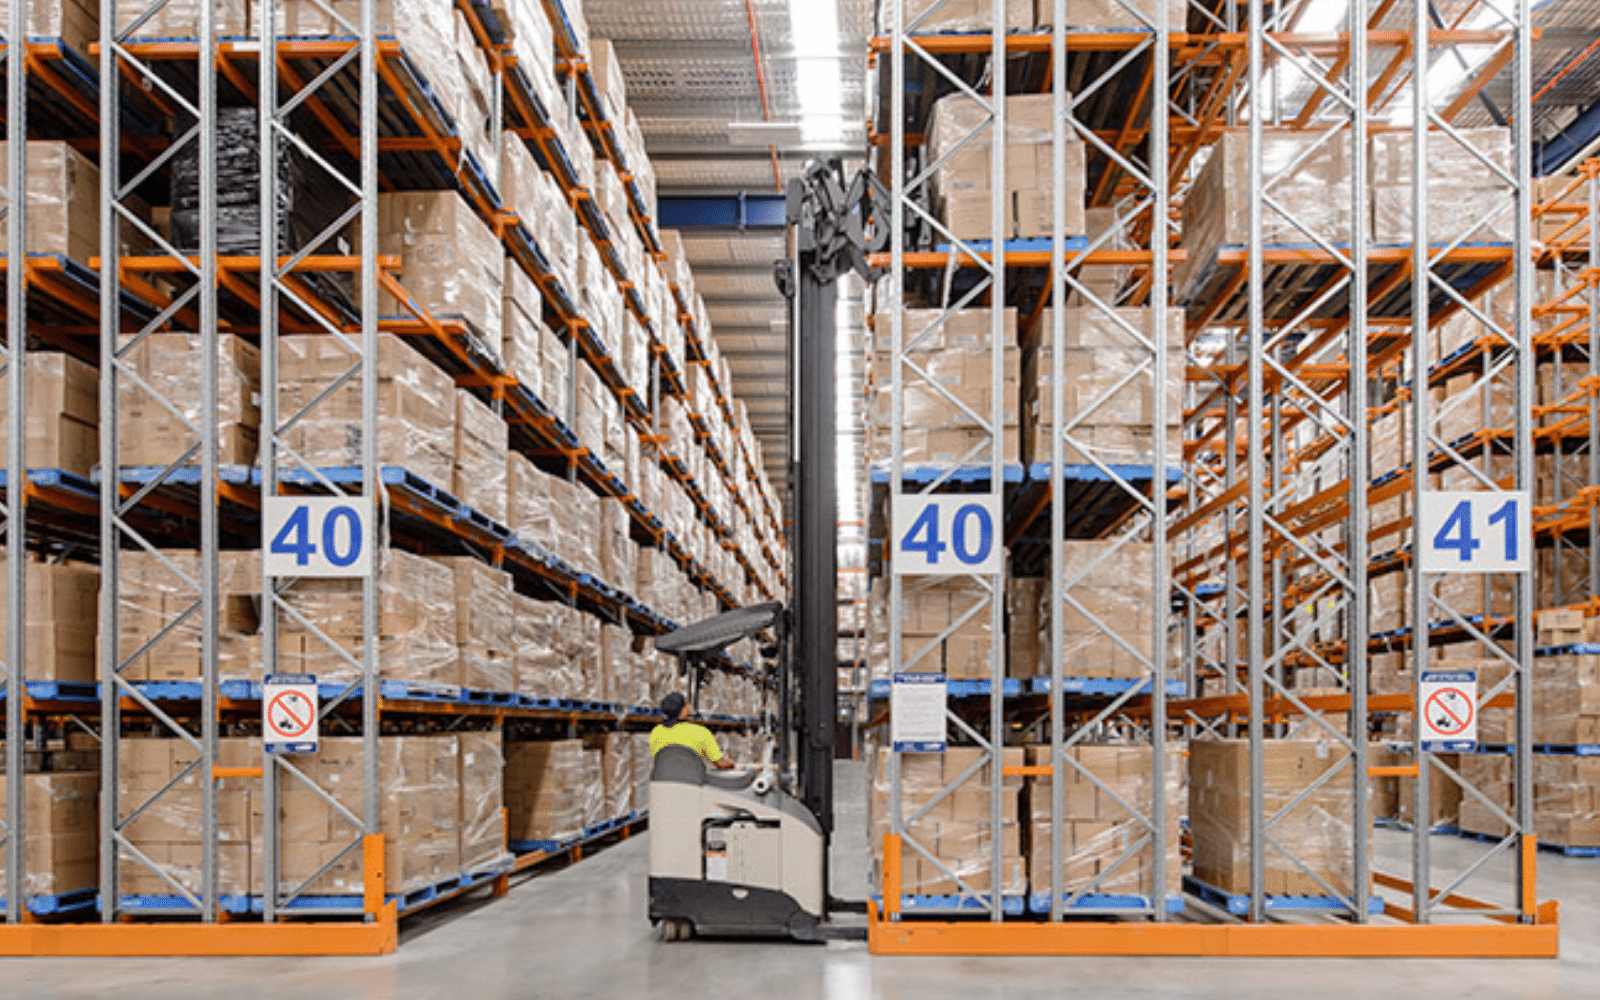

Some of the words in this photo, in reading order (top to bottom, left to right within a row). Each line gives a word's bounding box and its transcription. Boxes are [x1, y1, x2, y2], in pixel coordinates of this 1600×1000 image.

[271, 506, 362, 566] 40
[901, 504, 992, 564] 40
[1433, 500, 1517, 561] 41
